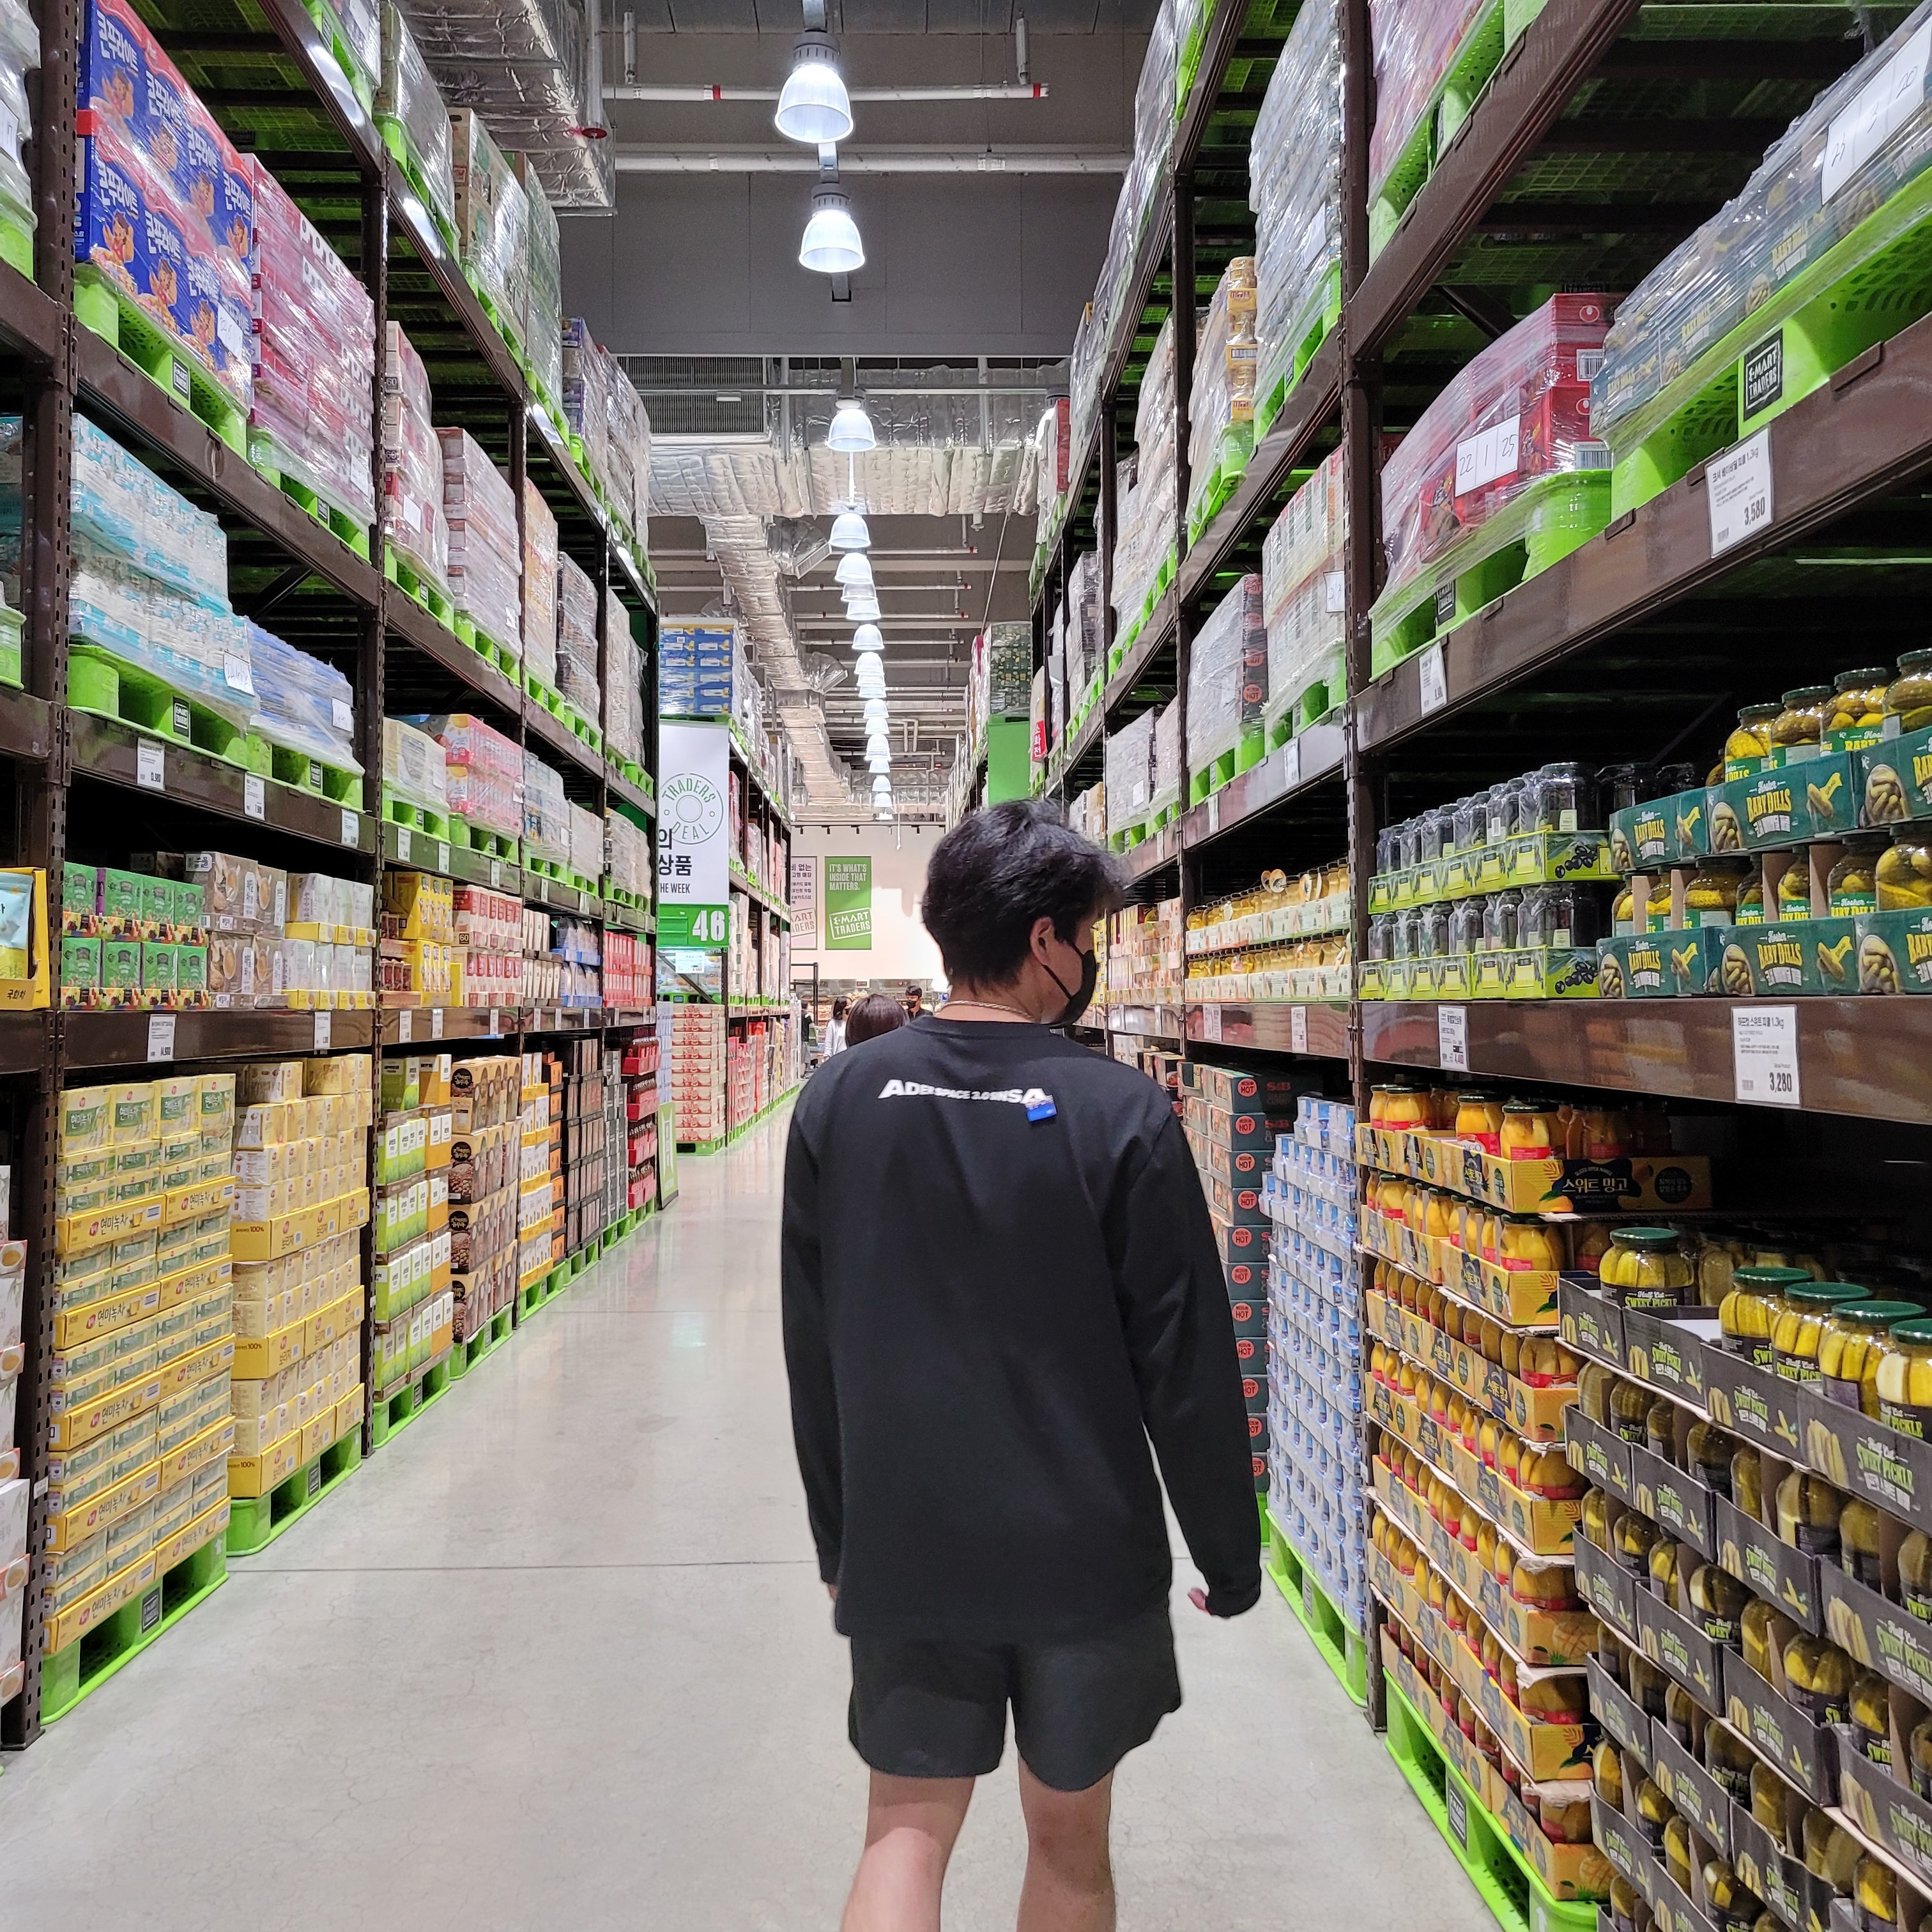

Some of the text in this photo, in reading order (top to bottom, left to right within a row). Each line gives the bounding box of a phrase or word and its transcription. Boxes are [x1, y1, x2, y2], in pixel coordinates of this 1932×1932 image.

[96, 10, 139, 73] 콘푸라이트
[98, 160, 139, 216] 콘푸라이트
[386, 378, 397, 386] 60
[1749, 372, 1777, 401] TRADERS
[1459, 452, 1475, 475] 22
[1501, 434, 1518, 460] 25
[1744, 496, 1766, 526] 3,580
[662, 777, 716, 804] TRADERS
[1745, 788, 1791, 823] BABY DILLS
[671, 821, 709, 840] DEAL
[1634, 818, 1666, 846] BABY DILLS
[659, 854, 692, 877] 상품
[829, 863, 867, 873] IT'S WHAT'S
[659, 883, 691, 894] HE WEEK
[829, 873, 866, 882] INSIDE THAT
[829, 882, 860, 891] MATTERS.
[692, 909, 725, 942] 46
[834, 920, 871, 935] TRADERS
[459, 933, 469, 942] 60
[1629, 949, 1660, 974] BABY DILLS
[1757, 942, 1803, 969] BABY DILLS
[1769, 1072, 1792, 1092] 3,280
[70, 1113, 93, 1129] 현미녹차
[1561, 1178, 1629, 1193] 스위트 망고
[190, 1191, 210, 1210] 현미녹차
[1241, 1198, 1254, 1206] HOT
[100, 1213, 129, 1236] 현미녹차
[281, 1234, 295, 1250] 보리차
[185, 1273, 206, 1293] 현미녹차
[1625, 1296, 1649, 1307] SWEET
[98, 1303, 126, 1328] 현미녹차
[187, 1356, 210, 1379] 현미녹차
[102, 1398, 130, 1425] 현미녹차
[187, 1443, 210, 1466] 현미녹차
[1856, 1442, 1883, 1473] SWEET
[1882, 1456, 1915, 1495] PICKLE
[98, 1493, 127, 1521] 현미녹차
[92, 1587, 120, 1618] 현미녹차
[1876, 1625, 1905, 1660] SWEET
